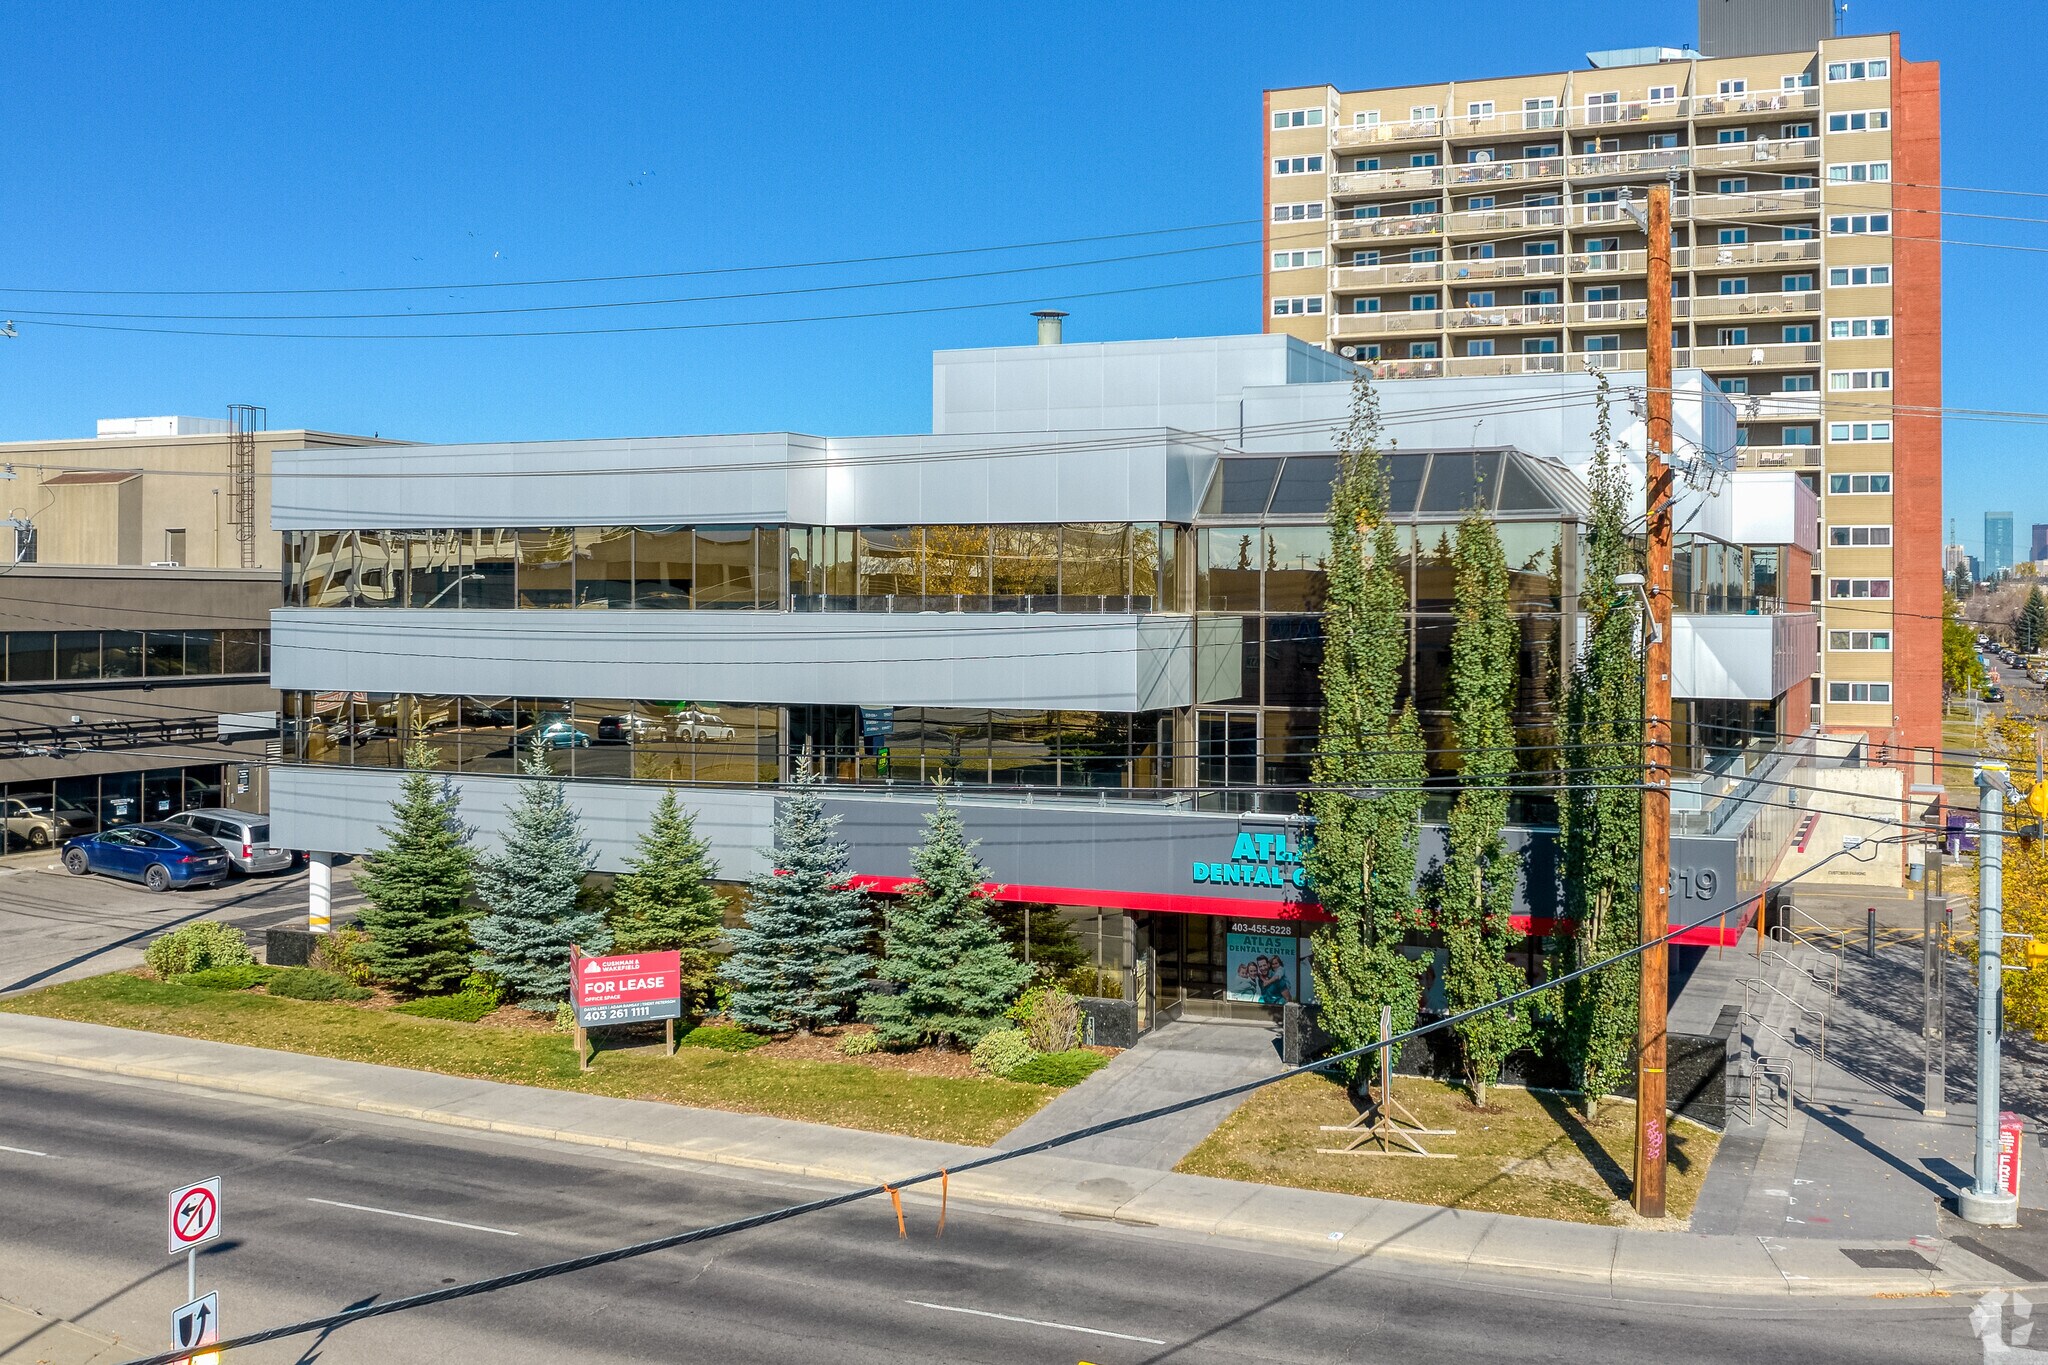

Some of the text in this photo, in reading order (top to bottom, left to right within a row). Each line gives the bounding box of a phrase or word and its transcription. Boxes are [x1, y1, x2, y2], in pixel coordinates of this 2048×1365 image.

[1231, 832, 1317, 862] ATL
[1192, 862, 1284, 887] DENTAL
[1231, 923, 1292, 936] 403-455-5228
[1243, 936, 1282, 947] ATLAS
[1229, 945, 1295, 956] DENTAL CENTRE
[602, 959, 634, 967] CUSHMAN
[602, 964, 640, 972] WAKEFIELD
[584, 977, 664, 995] FOR LEASE
[584, 1010, 607, 1021] 403
[609, 1008, 628, 1019] 261
[631, 1006, 650, 1017] 1111
